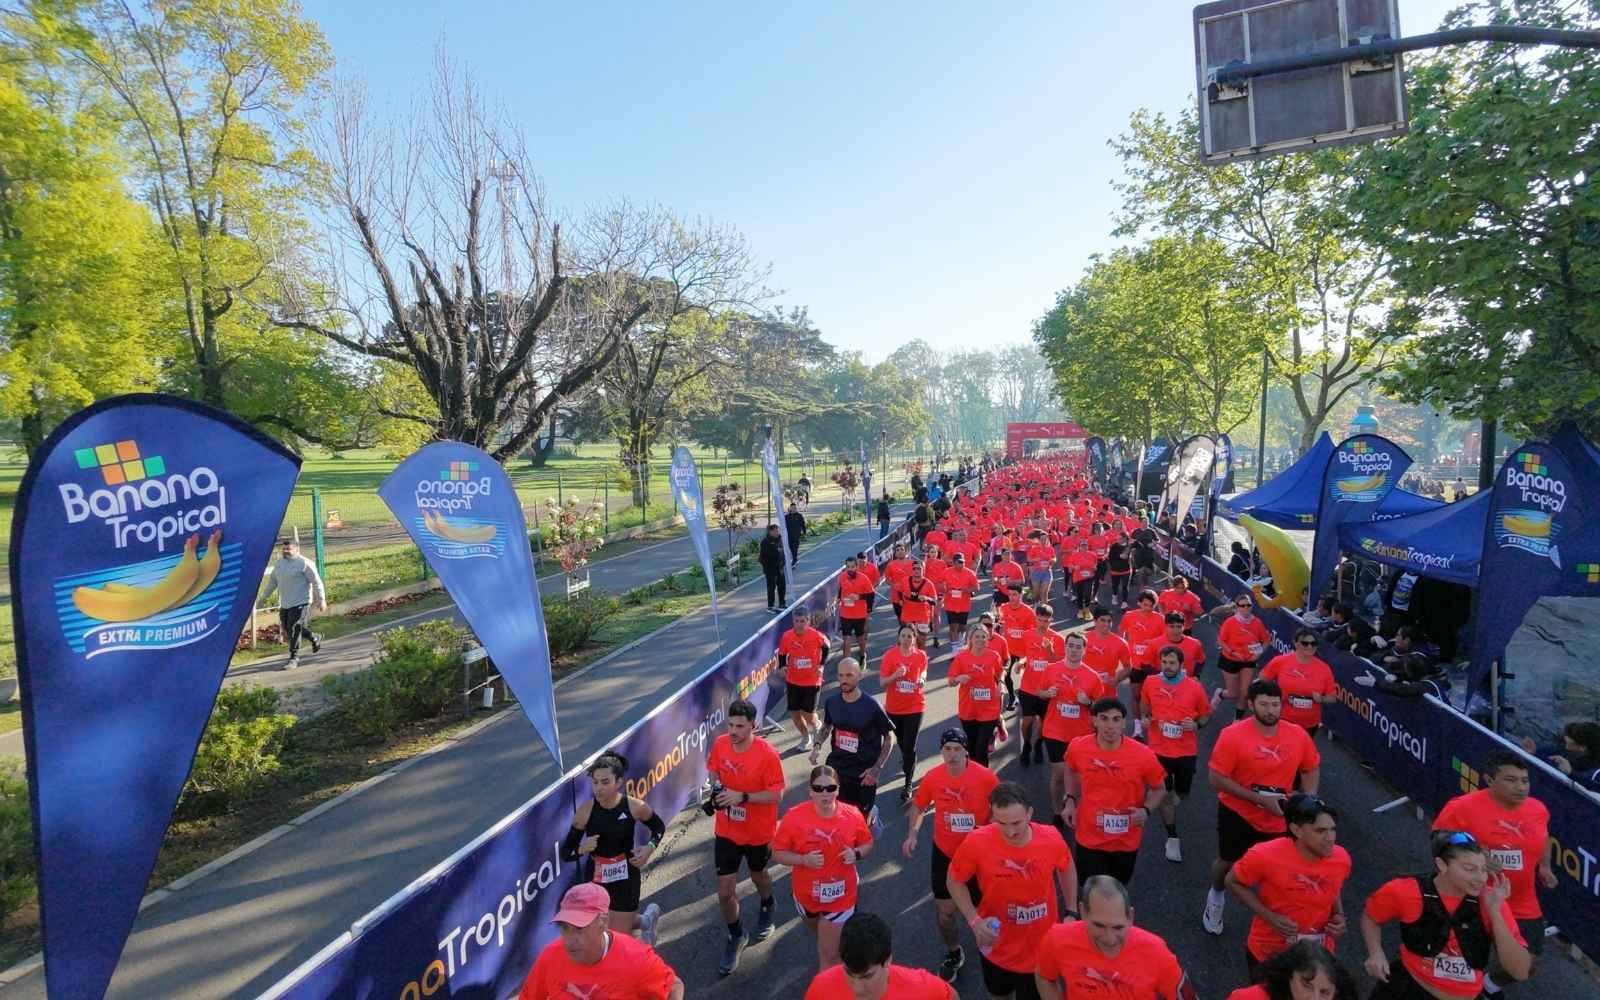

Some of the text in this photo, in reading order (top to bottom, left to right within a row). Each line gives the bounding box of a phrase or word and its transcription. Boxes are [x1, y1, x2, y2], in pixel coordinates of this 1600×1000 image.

[1338, 451, 1390, 464] Banana
[1352, 459, 1393, 475] Tropical
[1506, 467, 1566, 498] Banana
[58, 467, 219, 524] Banana
[105, 486, 227, 552] Tropical
[98, 618, 208, 645] EXTRA PREMIUM
[625, 702, 726, 801] BananaTropical
[1334, 682, 1427, 764] ananaTropical
[400, 841, 562, 1000] naTropical
